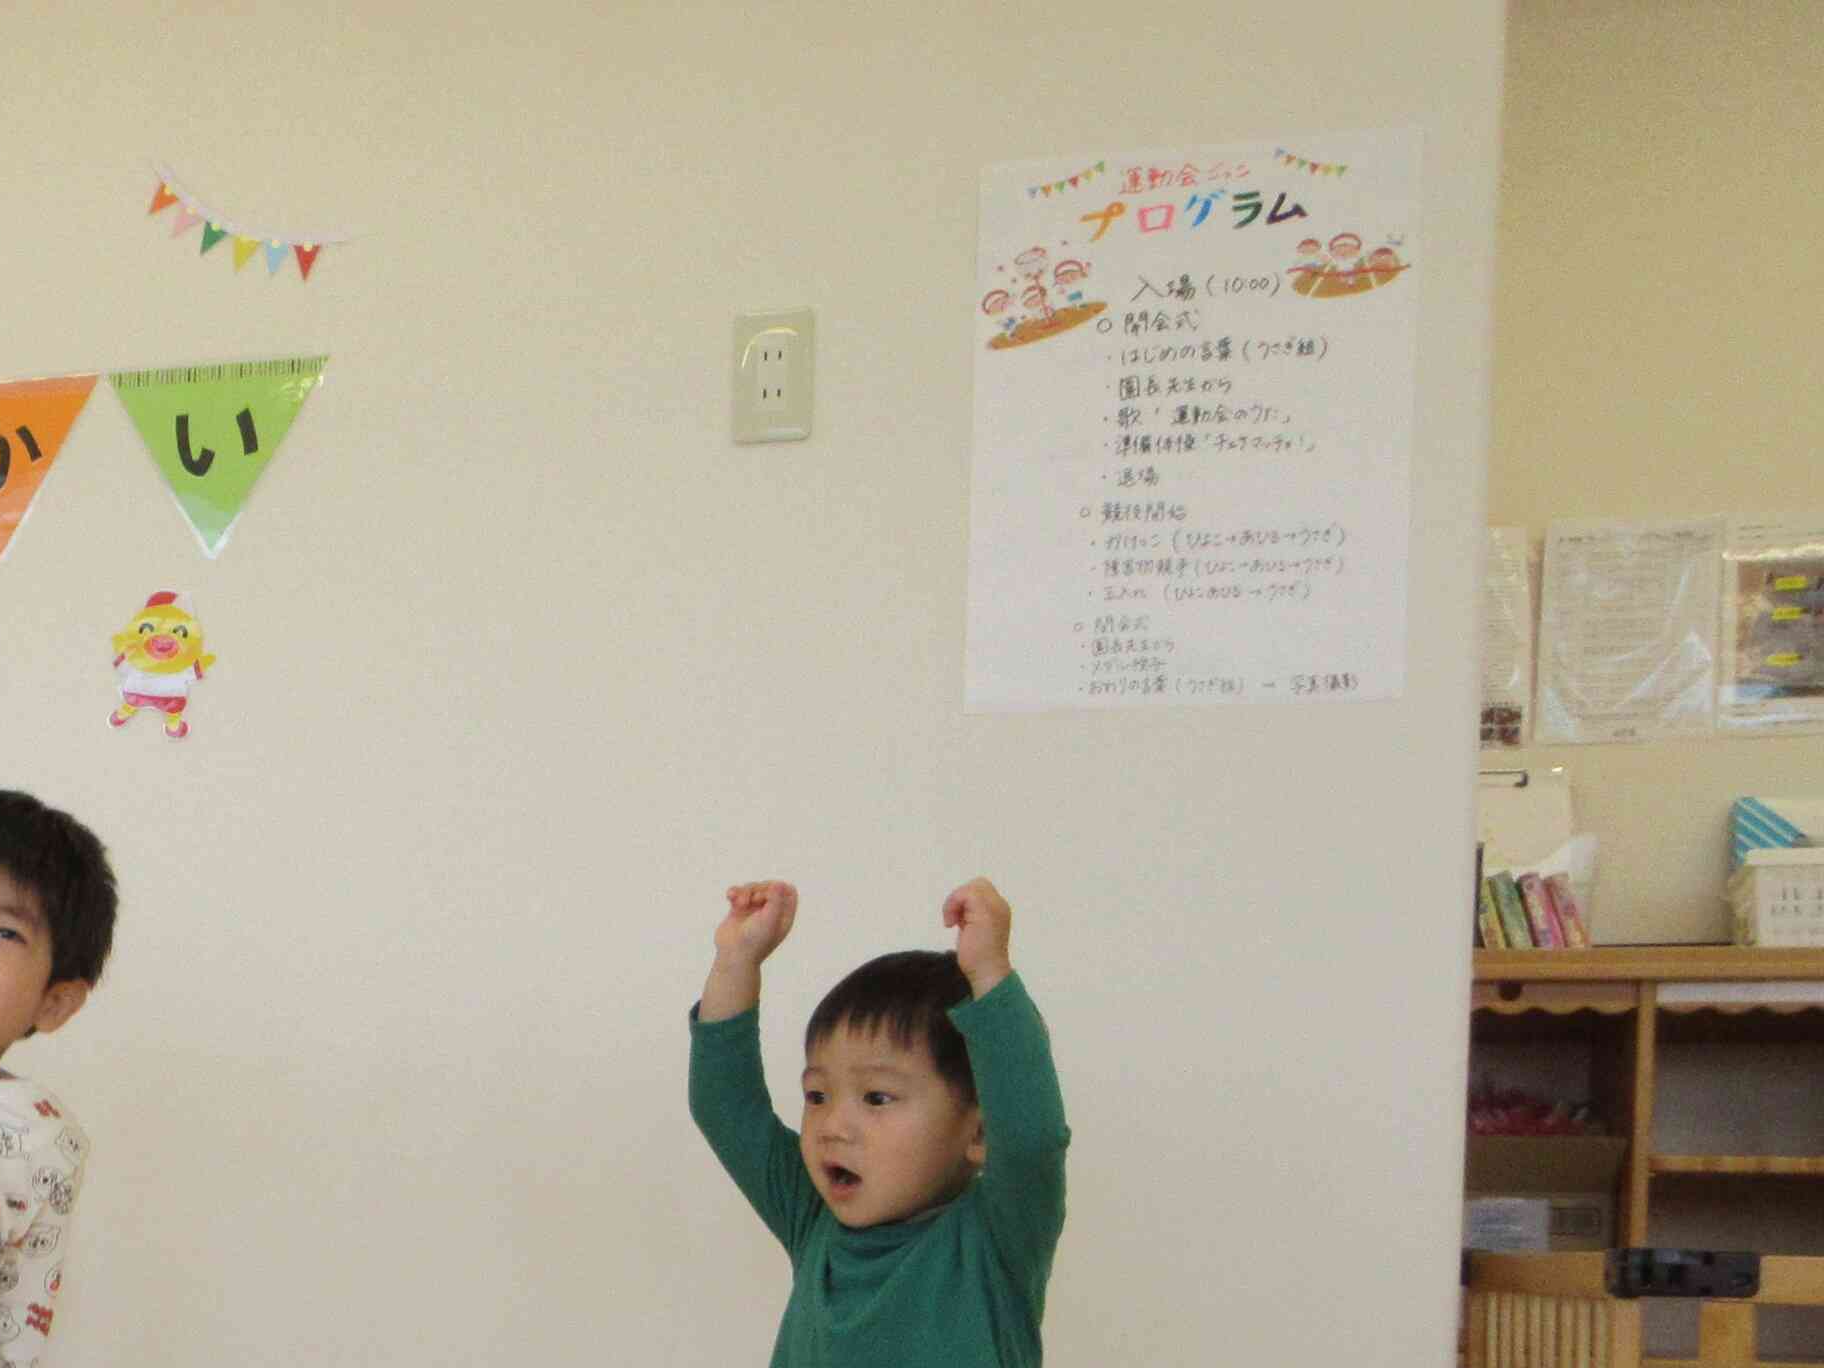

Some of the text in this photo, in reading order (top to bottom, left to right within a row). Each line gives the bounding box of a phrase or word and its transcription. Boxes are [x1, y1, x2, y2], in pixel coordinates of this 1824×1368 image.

[1080, 188, 1308, 242] プログラム
